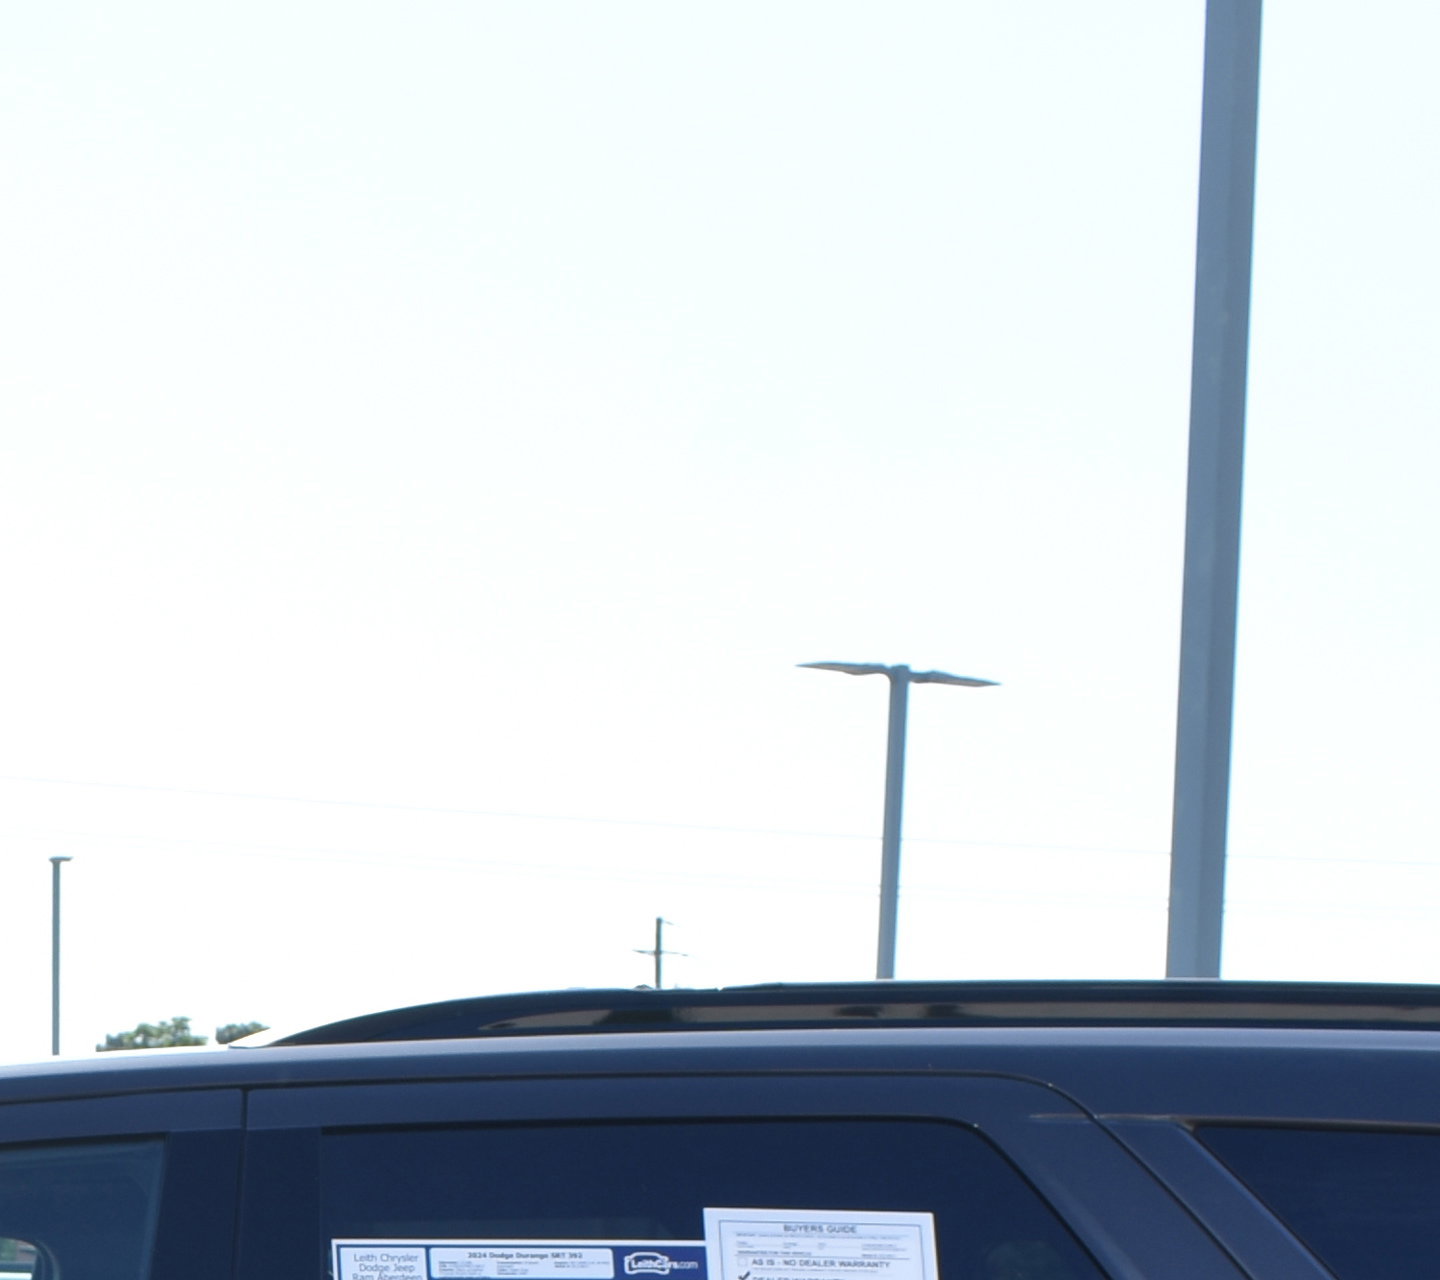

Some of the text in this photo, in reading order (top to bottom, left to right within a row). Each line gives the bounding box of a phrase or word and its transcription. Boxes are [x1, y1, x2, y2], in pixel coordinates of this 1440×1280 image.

[783, 1224, 857, 1233] BUYERS GUIDE
[353, 1253, 418, 1264] Leith Chrysler
[489, 1252, 514, 1260] Dodge
[359, 1263, 416, 1273] Dodge Jeep
[839, 1260, 891, 1268] WARRANTY
[352, 1272, 423, 1280] Ram Aberdeen
